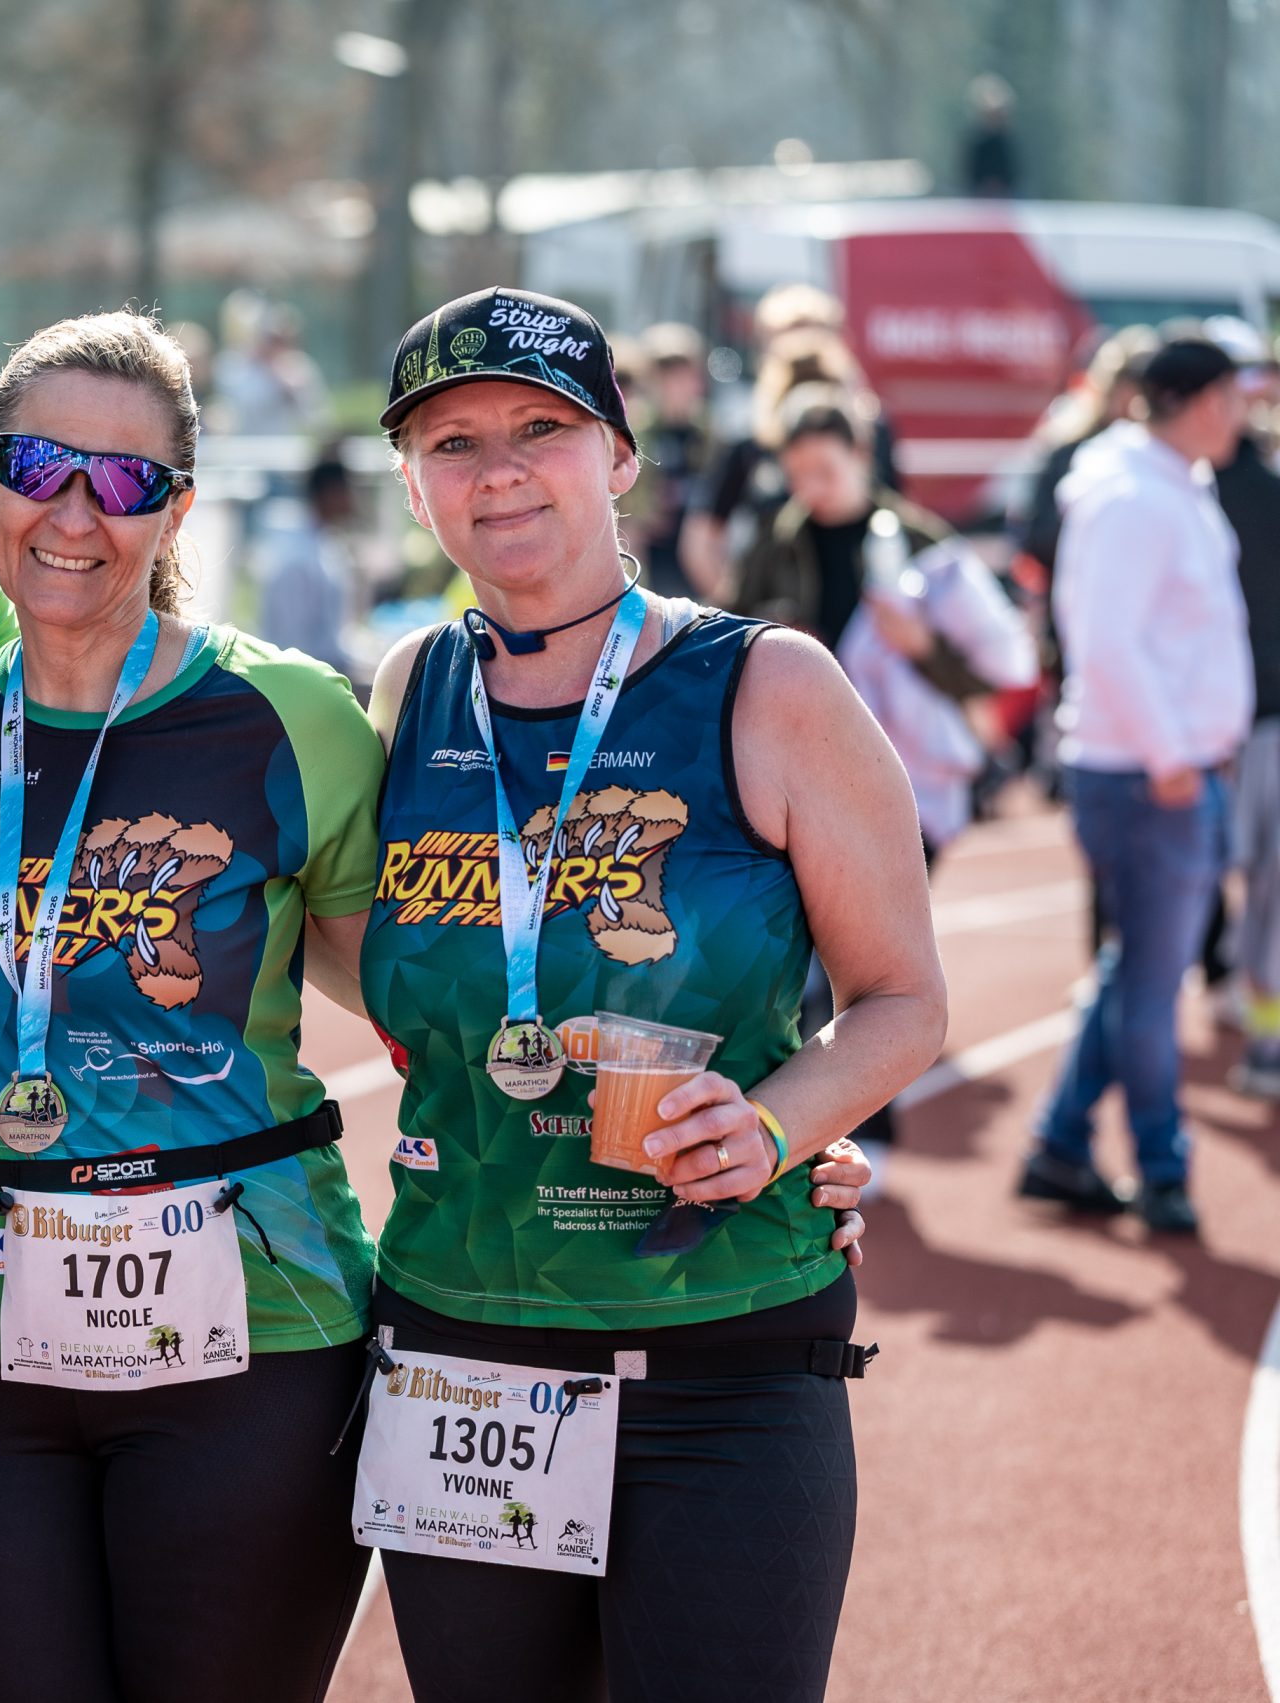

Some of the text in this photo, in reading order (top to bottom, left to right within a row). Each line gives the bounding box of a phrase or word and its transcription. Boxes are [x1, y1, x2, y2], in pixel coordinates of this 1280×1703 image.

[494, 298, 536, 312] RUN THE
[488, 307, 560, 335] Strip
[508, 330, 589, 362] Night
[591, 693, 604, 718] 2026
[587, 751, 656, 769] ERMANY
[412, 831, 507, 857] UNITE
[2, 891, 10, 917] 2026
[396, 901, 444, 925] OF
[39, 896, 58, 990] MARATHON 2026
[505, 1078, 549, 1088] MARATHON
[536, 1185, 667, 1200] Tri Treff Heinz Storz
[161, 1200, 204, 1237] 0.0
[537, 1206, 550, 1216] Ihr
[552, 1207, 598, 1218] Spezialist
[599, 1206, 615, 1217] für
[32, 1204, 133, 1247] Bitburger
[553, 1221, 596, 1231] Radcross
[599, 1221, 606, 1231] &
[62, 1249, 172, 1299] 1707
[86, 1307, 154, 1329] NICOLE
[59, 1342, 136, 1354] BIENWALD
[203, 1348, 236, 1360] KANDEL
[218, 1341, 231, 1349] TSV
[60, 1353, 147, 1368] MARATHON
[92, 1370, 120, 1380] Bitburger
[407, 1366, 503, 1411] Bitburger
[429, 1414, 536, 1471] 1305
[442, 1472, 514, 1500] YVONNE
[416, 1505, 489, 1524] BIENWALD
[415, 1518, 499, 1539] MARATHON
[444, 1536, 472, 1549] Bitburger
[557, 1543, 592, 1555] KANDEL
[574, 1537, 589, 1545] TSV
